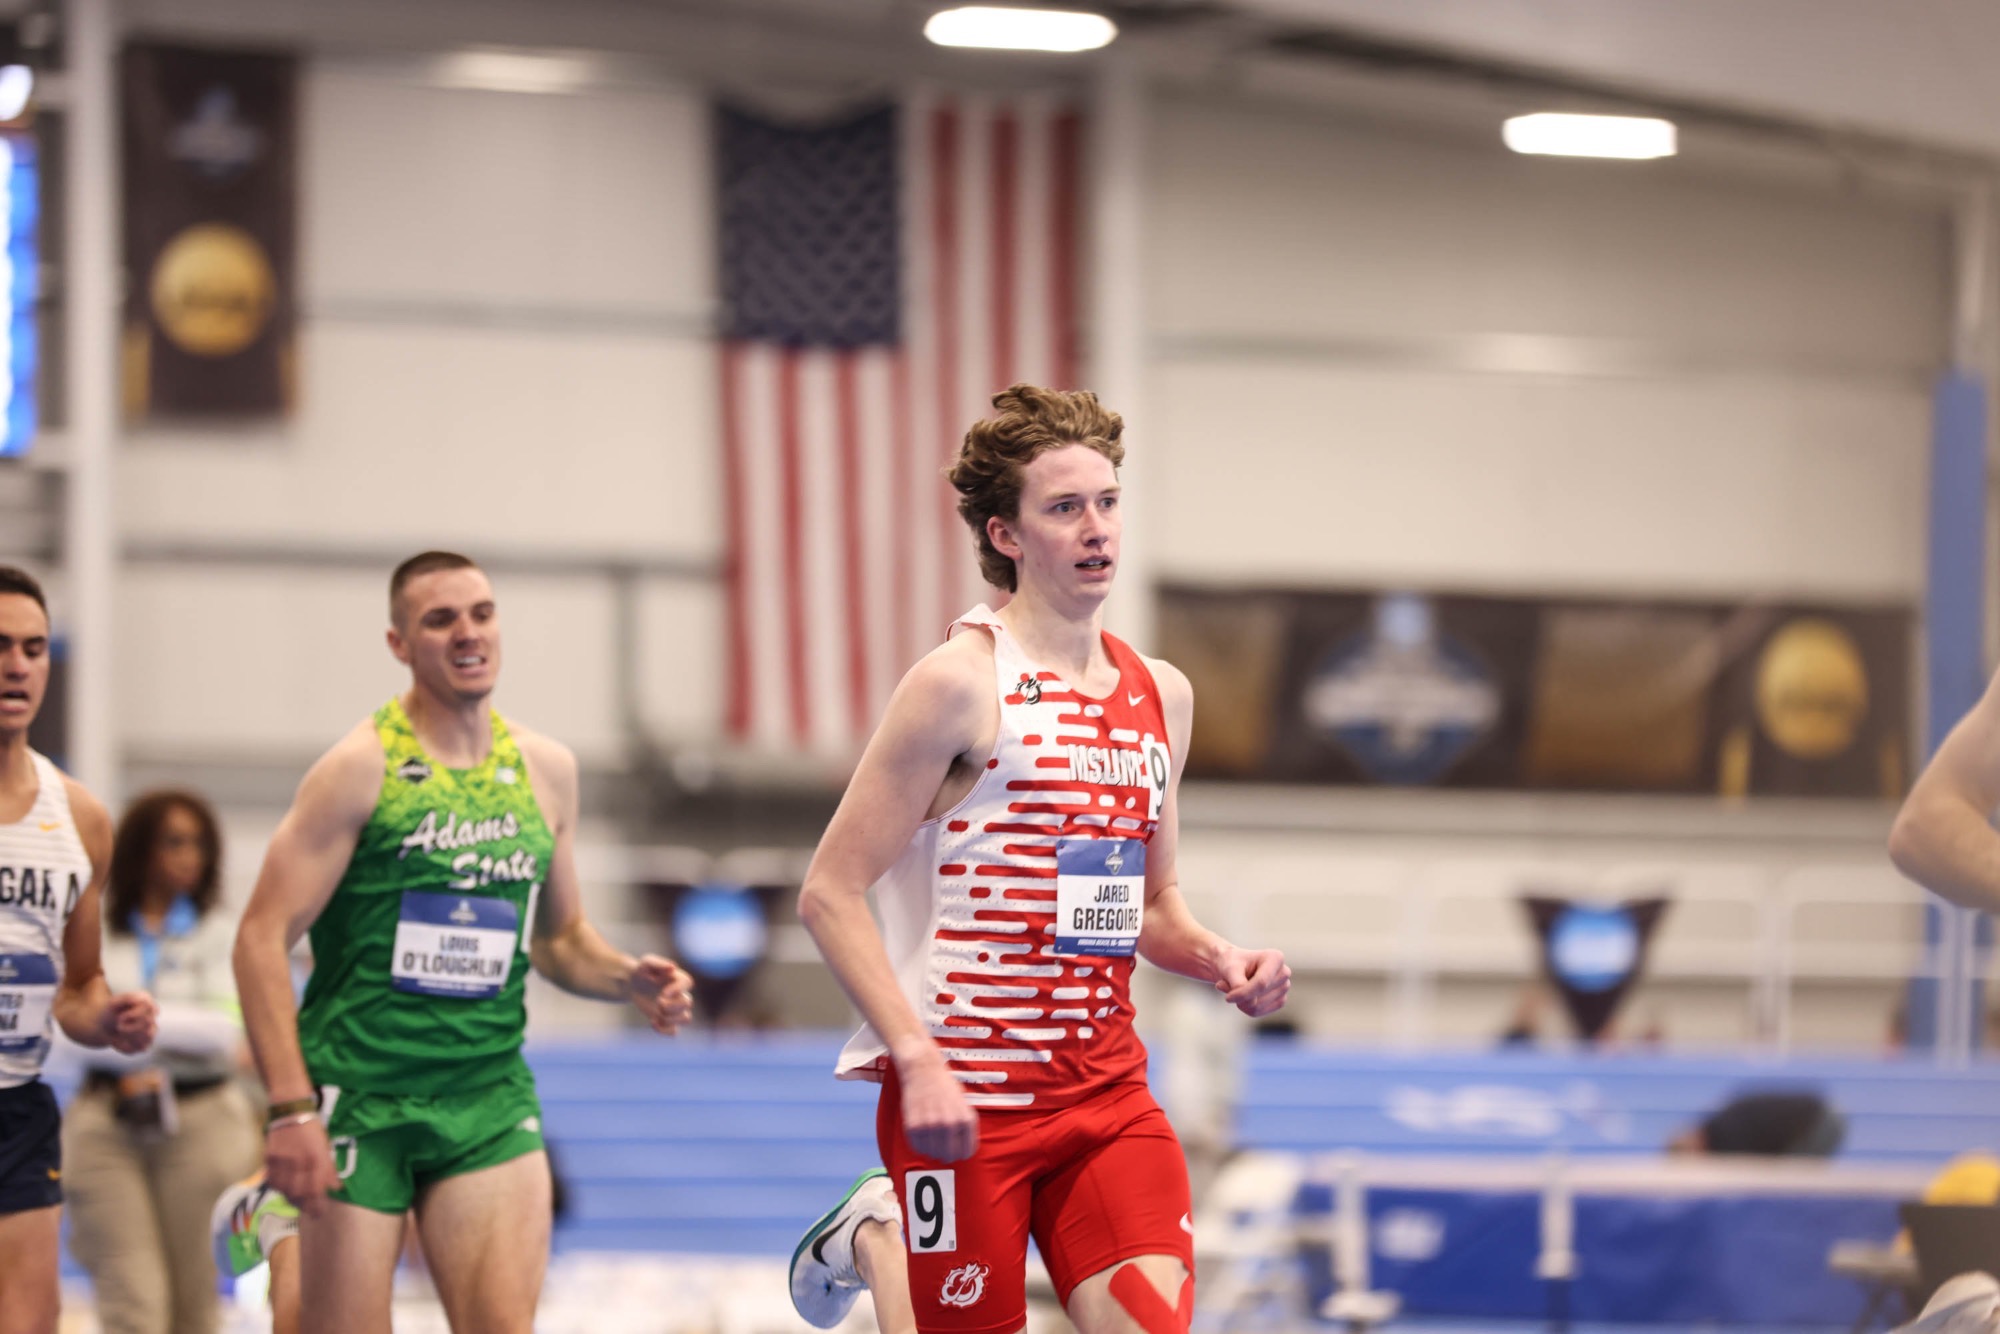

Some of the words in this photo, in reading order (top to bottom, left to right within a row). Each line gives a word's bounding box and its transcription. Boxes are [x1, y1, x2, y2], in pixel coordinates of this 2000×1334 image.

[1067, 743, 1143, 788] MSUM
[1149, 746, 1166, 815] 9
[398, 810, 520, 860] Adams
[448, 848, 537, 889] State
[1094, 884, 1129, 903] JARED
[1073, 907, 1138, 931] GREGOIRE
[439, 935, 480, 951] LOUIS
[402, 951, 505, 978] O'LOUGHLIN
[914, 1175, 944, 1249] 9
